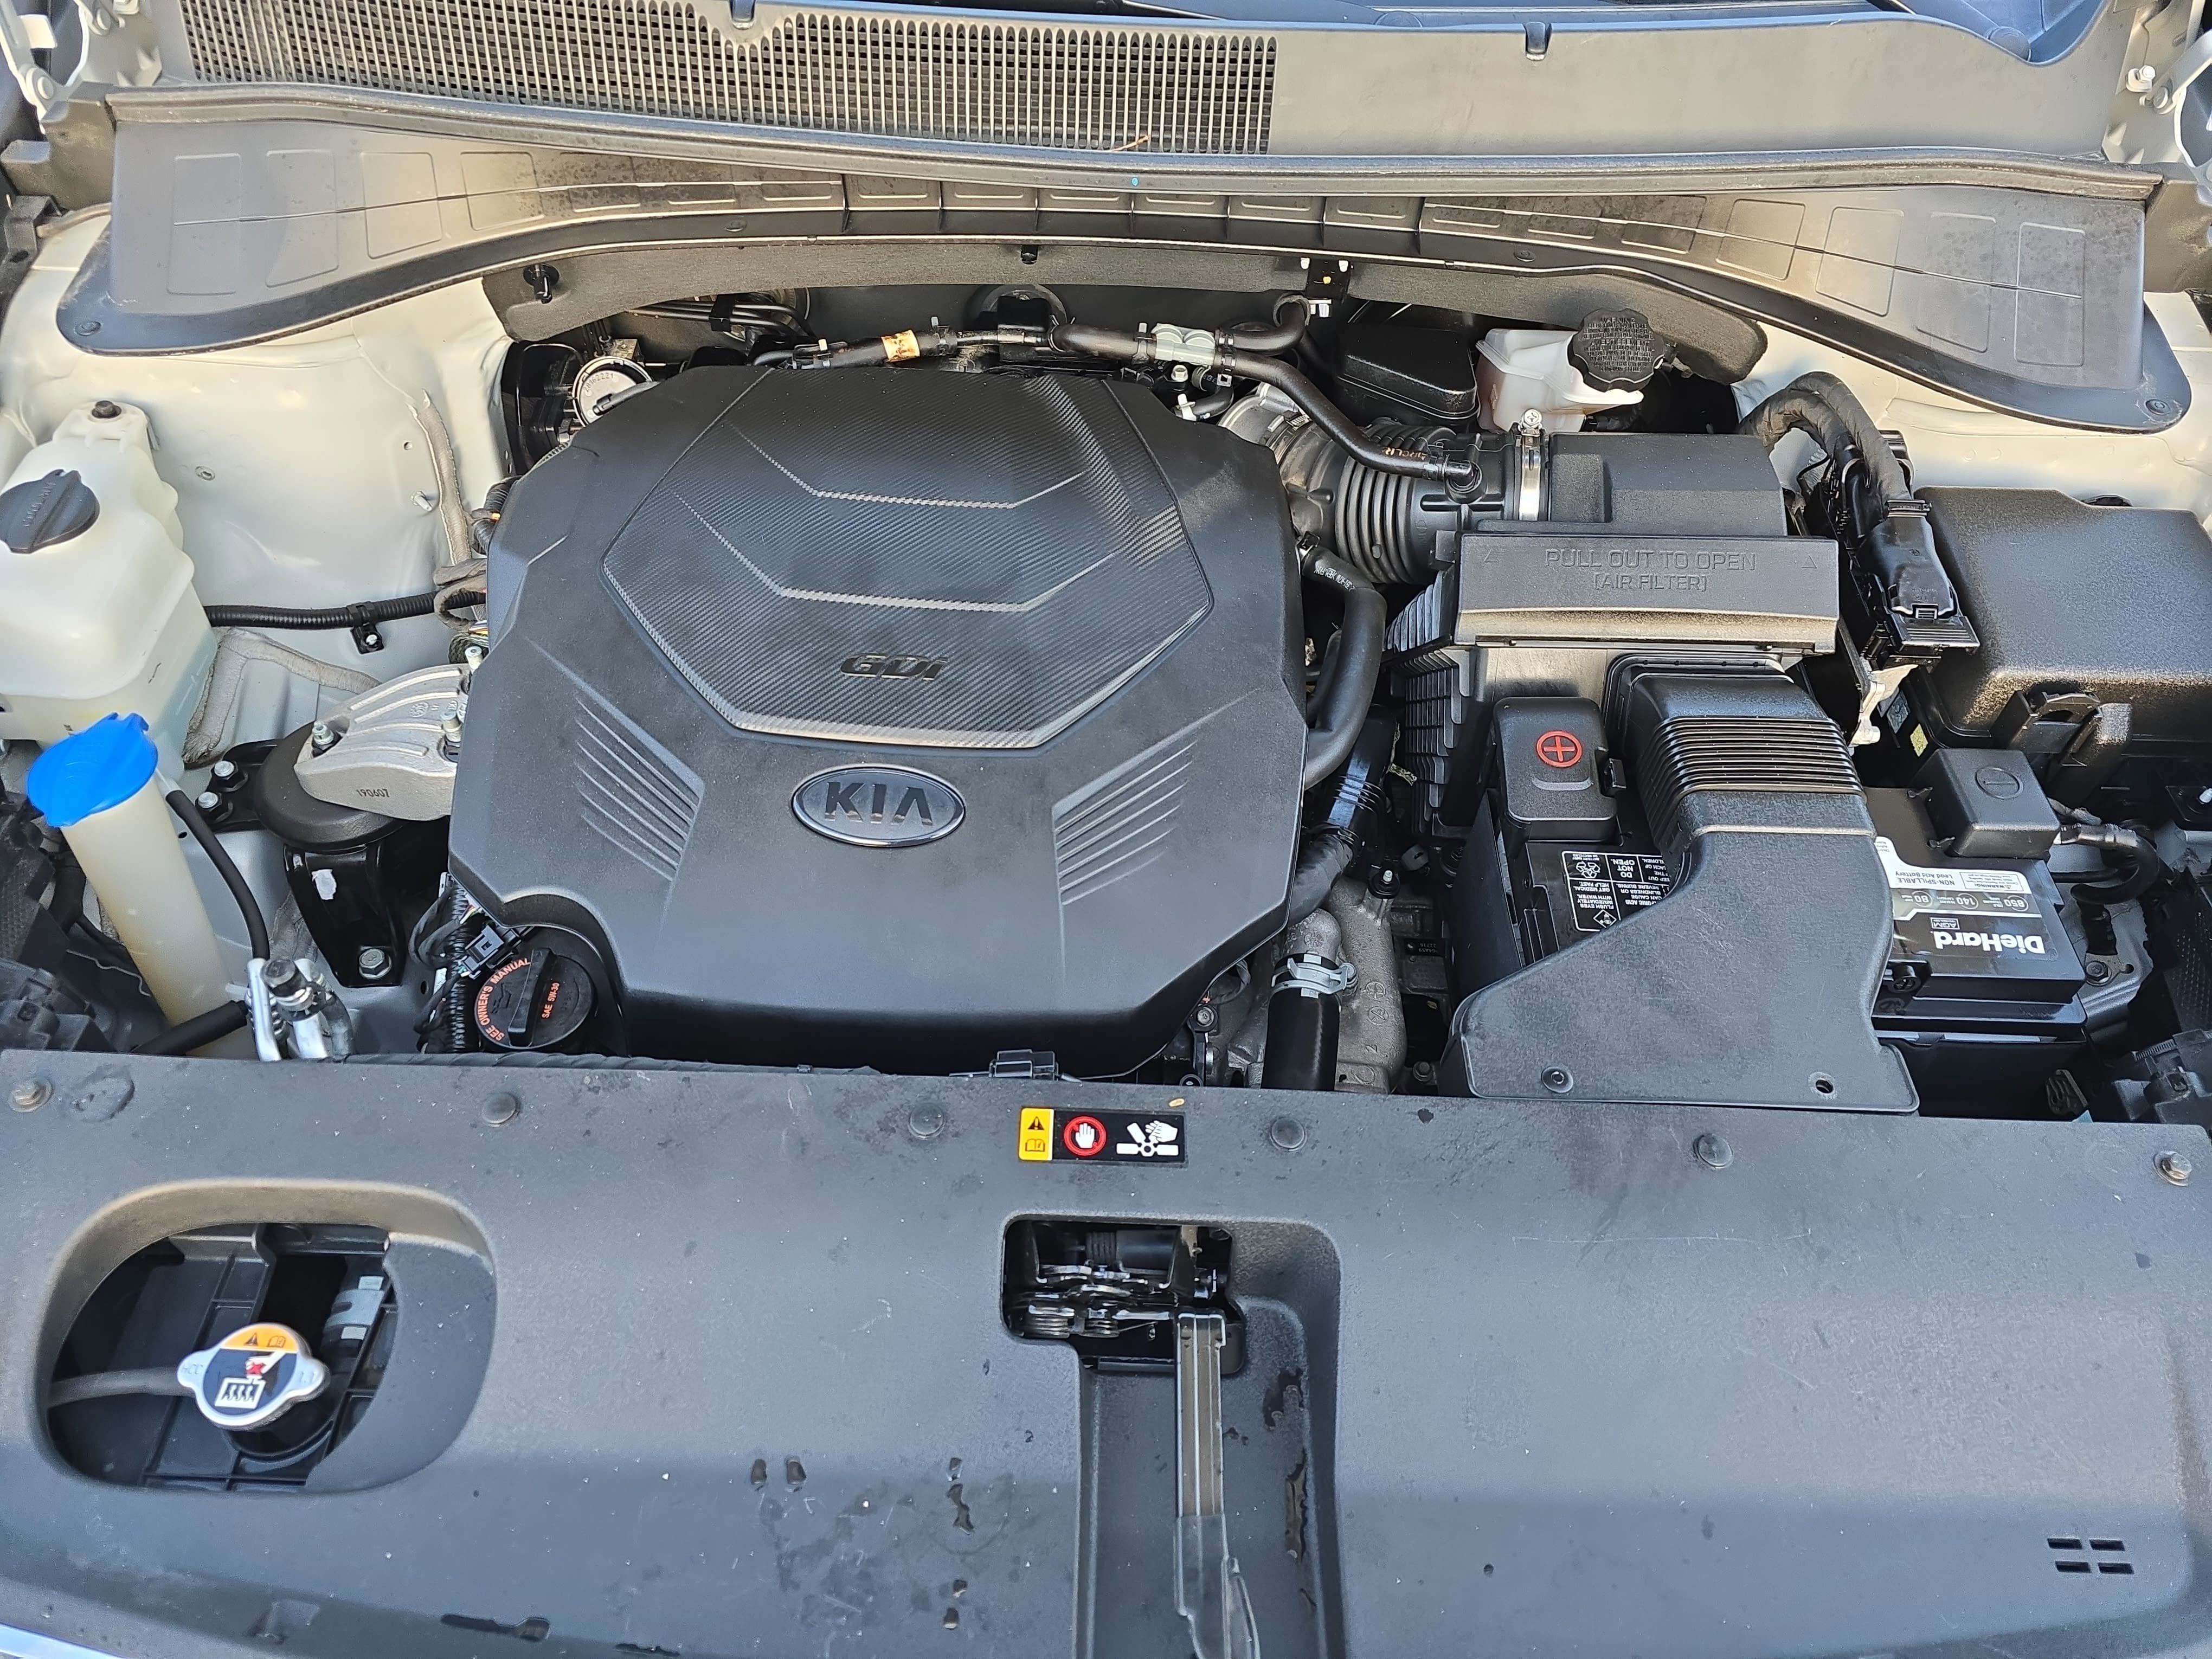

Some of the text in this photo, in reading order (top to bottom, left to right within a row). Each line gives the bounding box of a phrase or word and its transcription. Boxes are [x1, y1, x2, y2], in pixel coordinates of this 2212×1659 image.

[1545, 549, 1756, 571] PULL OUT TO OPEN
[824, 781, 933, 826] KIA
[1896, 877, 1955, 886] NON-SPILLABLE
[1956, 897, 1976, 905] 140
[2003, 899, 2025, 908] 850
[1933, 931, 2046, 954] DieHard
[477, 958, 531, 1041] SEE OWNER'S MANUAL
[542, 1004, 553, 1019] SAE
